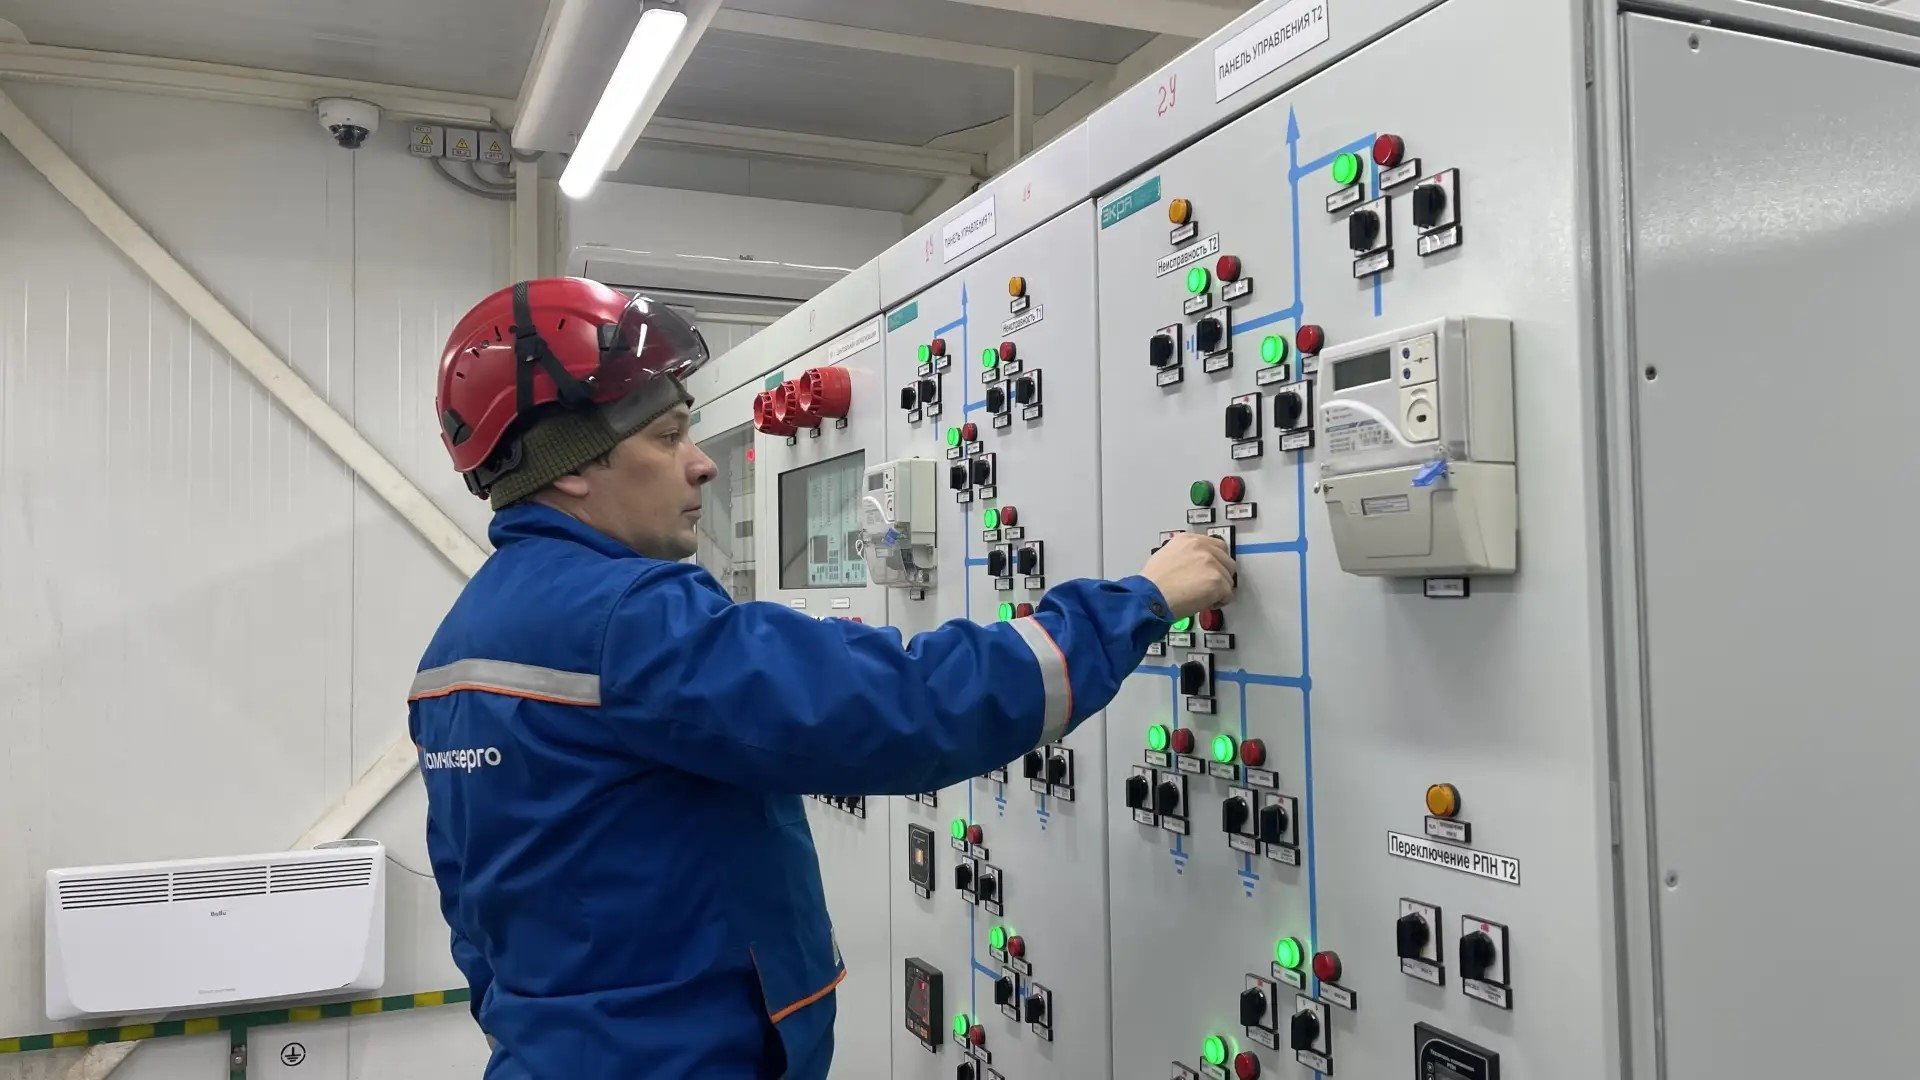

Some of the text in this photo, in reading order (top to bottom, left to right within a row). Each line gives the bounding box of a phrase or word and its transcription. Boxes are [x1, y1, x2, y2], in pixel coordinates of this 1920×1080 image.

[1219, 5, 1323, 80] ПАНЕЛЬ УПРАВЛЕНИЯ Т2
[1158, 236, 1217, 273] Неисправность Т2
[1391, 835, 1517, 880] Переключение РПН Т2
